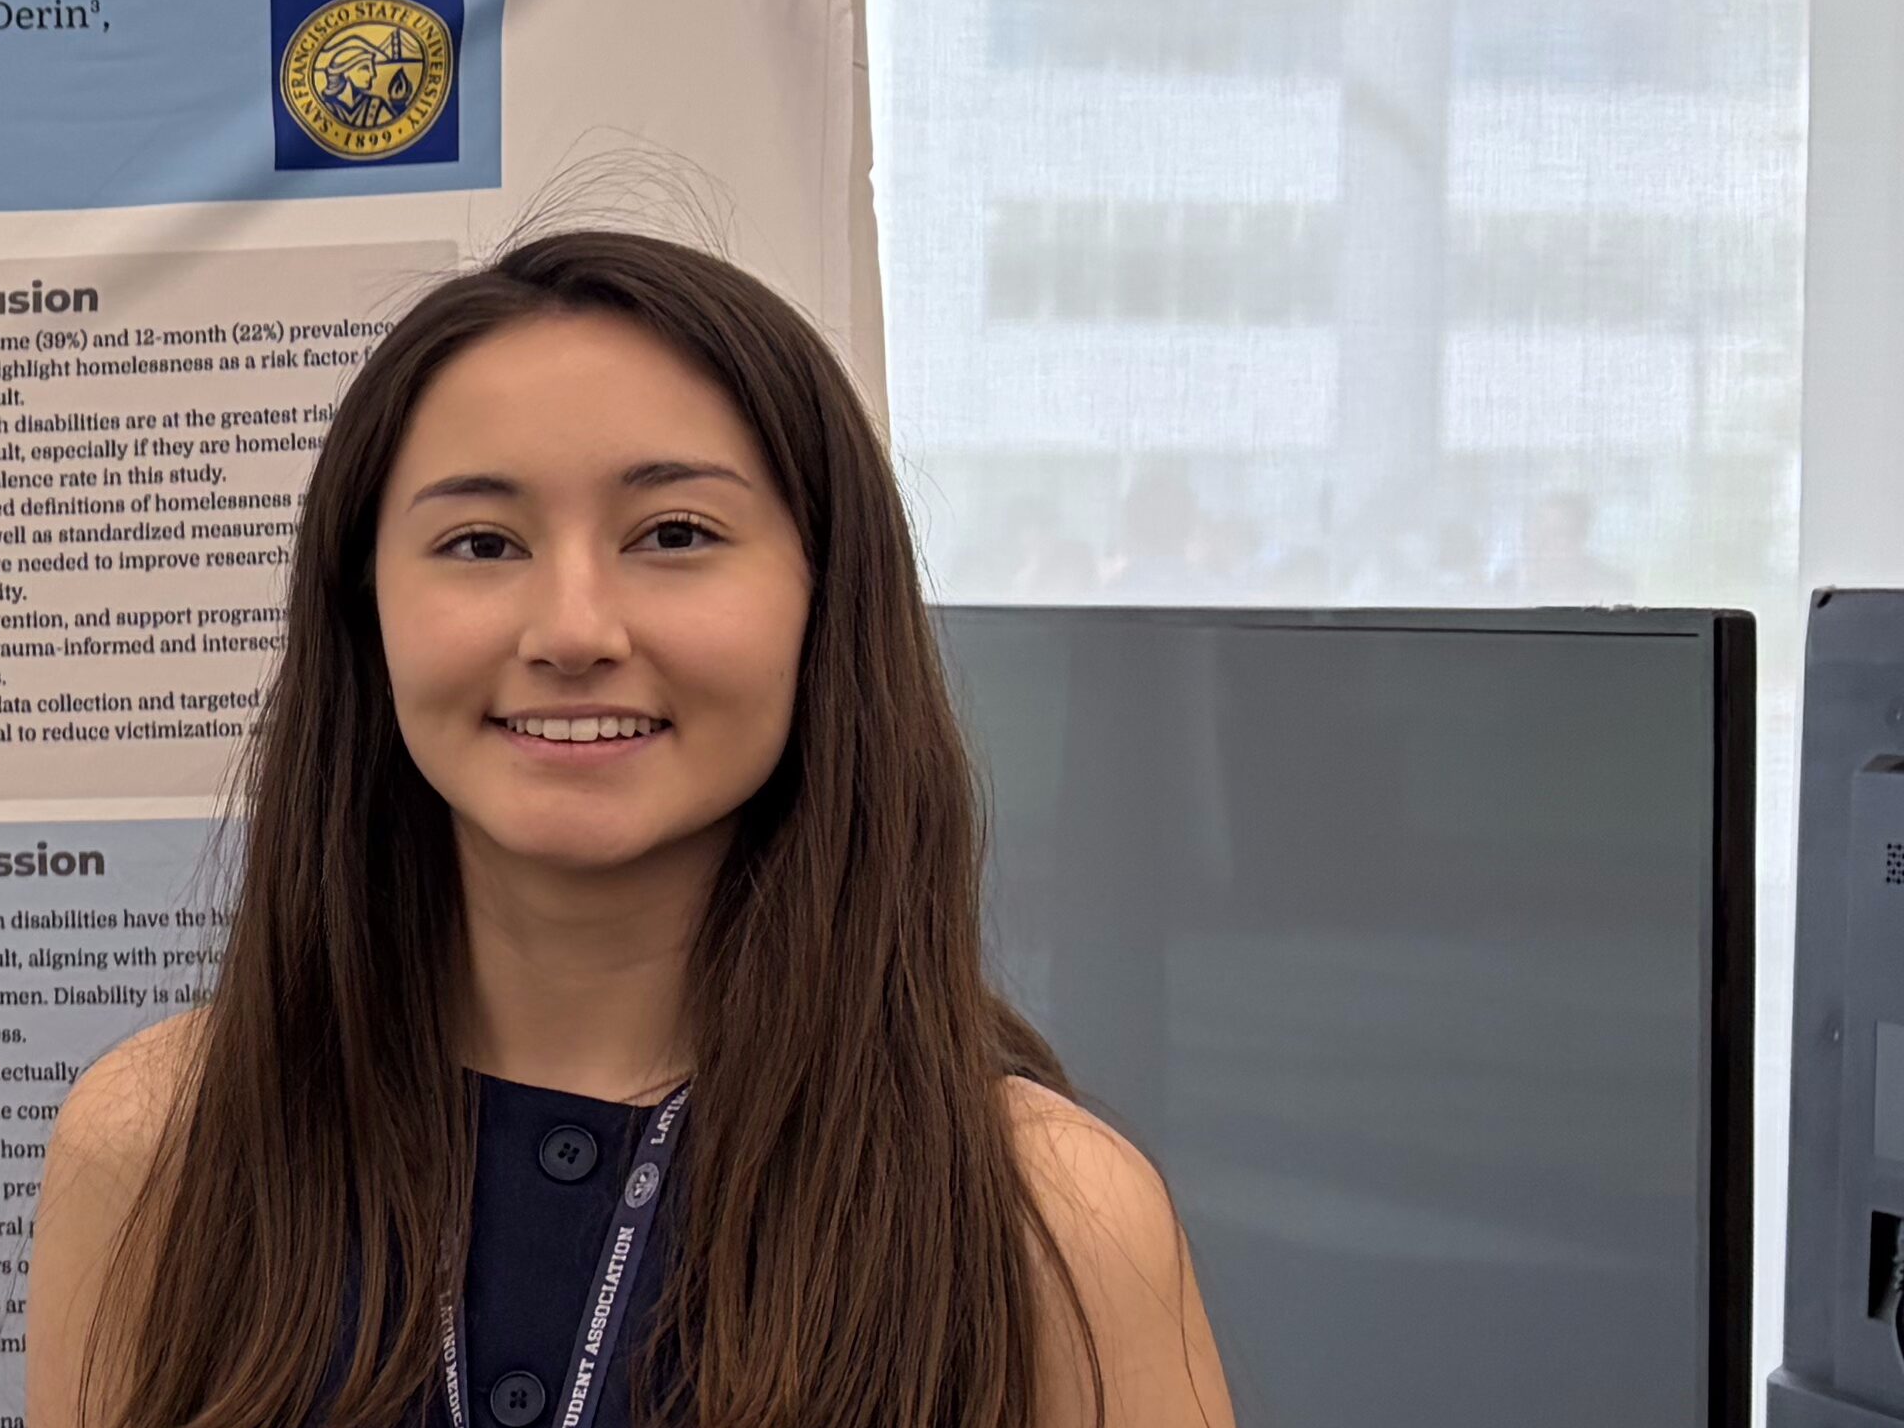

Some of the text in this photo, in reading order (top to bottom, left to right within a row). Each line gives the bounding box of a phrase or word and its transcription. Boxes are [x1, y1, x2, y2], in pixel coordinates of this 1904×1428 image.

[290, 0, 444, 134] SAN FRANCISCO STATE UNIVERSITY
[343, 129, 393, 150] 1899
[35, 327, 88, 354] (39%)
[92, 327, 130, 349] and
[135, 323, 227, 348] 12-month
[231, 319, 285, 346] (22%)
[10, 909, 118, 931] disabilities
[123, 907, 170, 929] have
[174, 906, 207, 930] the
[583, 1225, 637, 1356] ASSOCIATION
